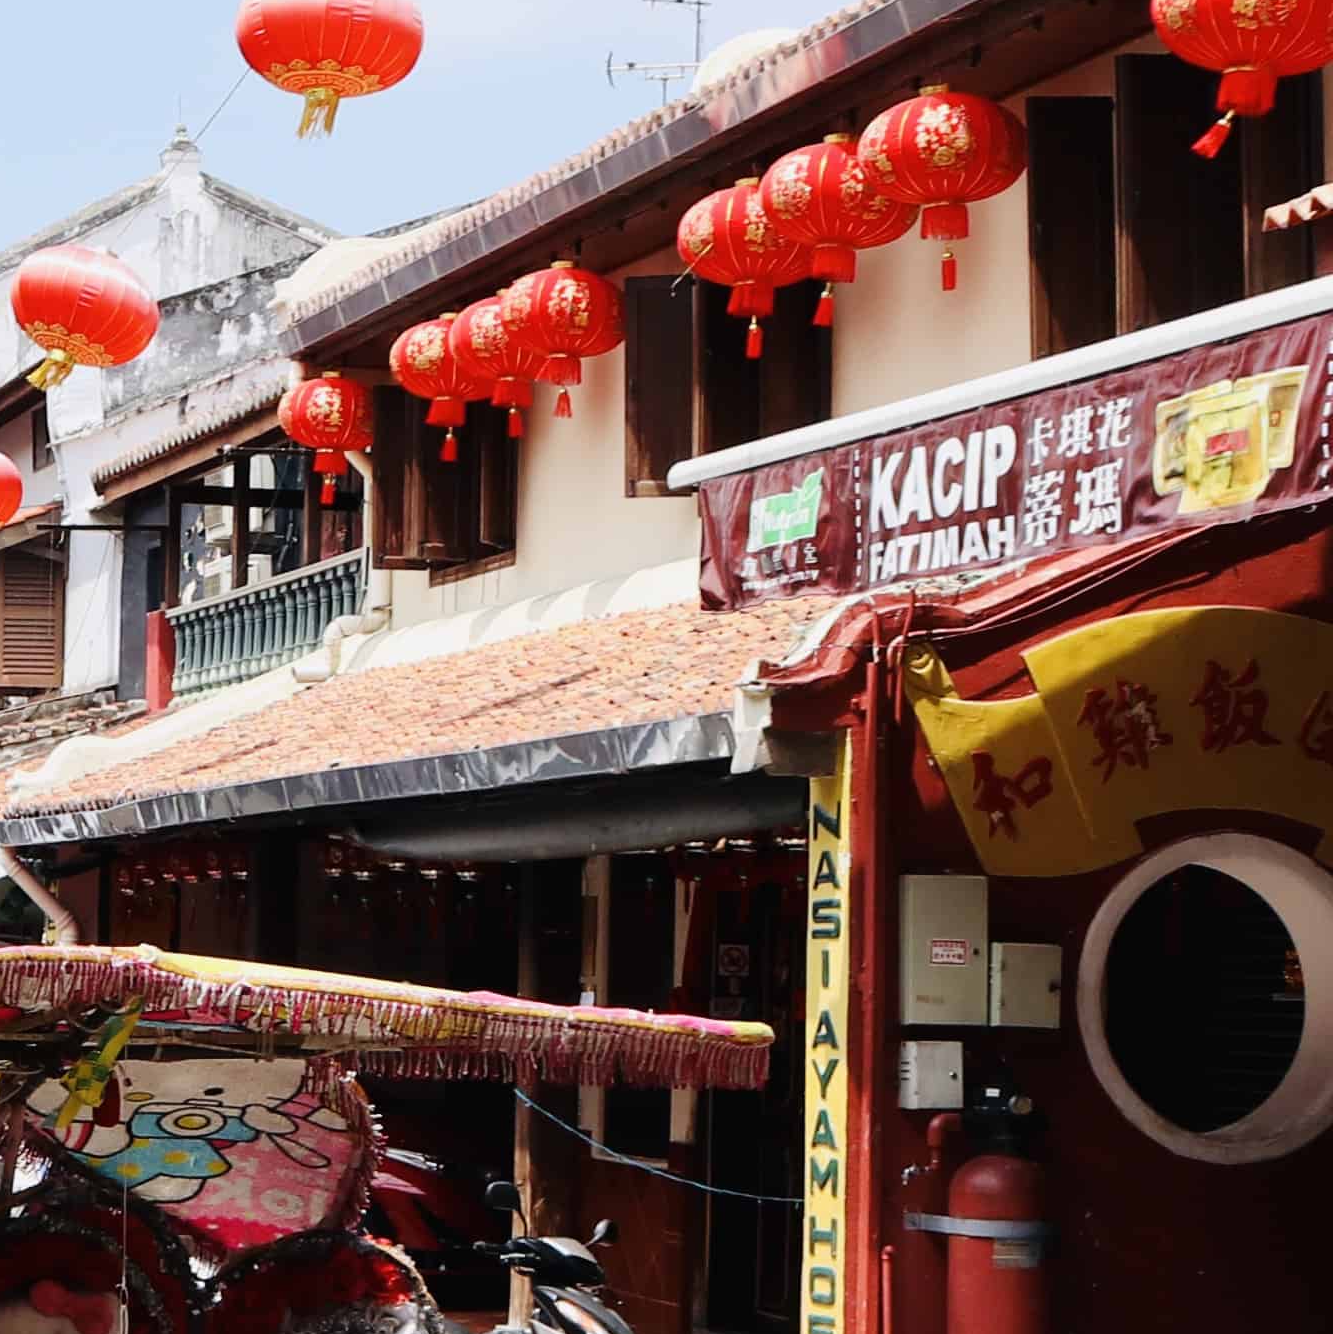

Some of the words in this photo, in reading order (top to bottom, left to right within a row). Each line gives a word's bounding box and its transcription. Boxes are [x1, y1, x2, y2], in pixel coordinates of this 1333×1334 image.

[868, 514, 1017, 584] FATIMAH
[869, 423, 1018, 534] KACIP
[811, 800, 843, 990] NASI
[808, 1009, 841, 1198] AYAM
